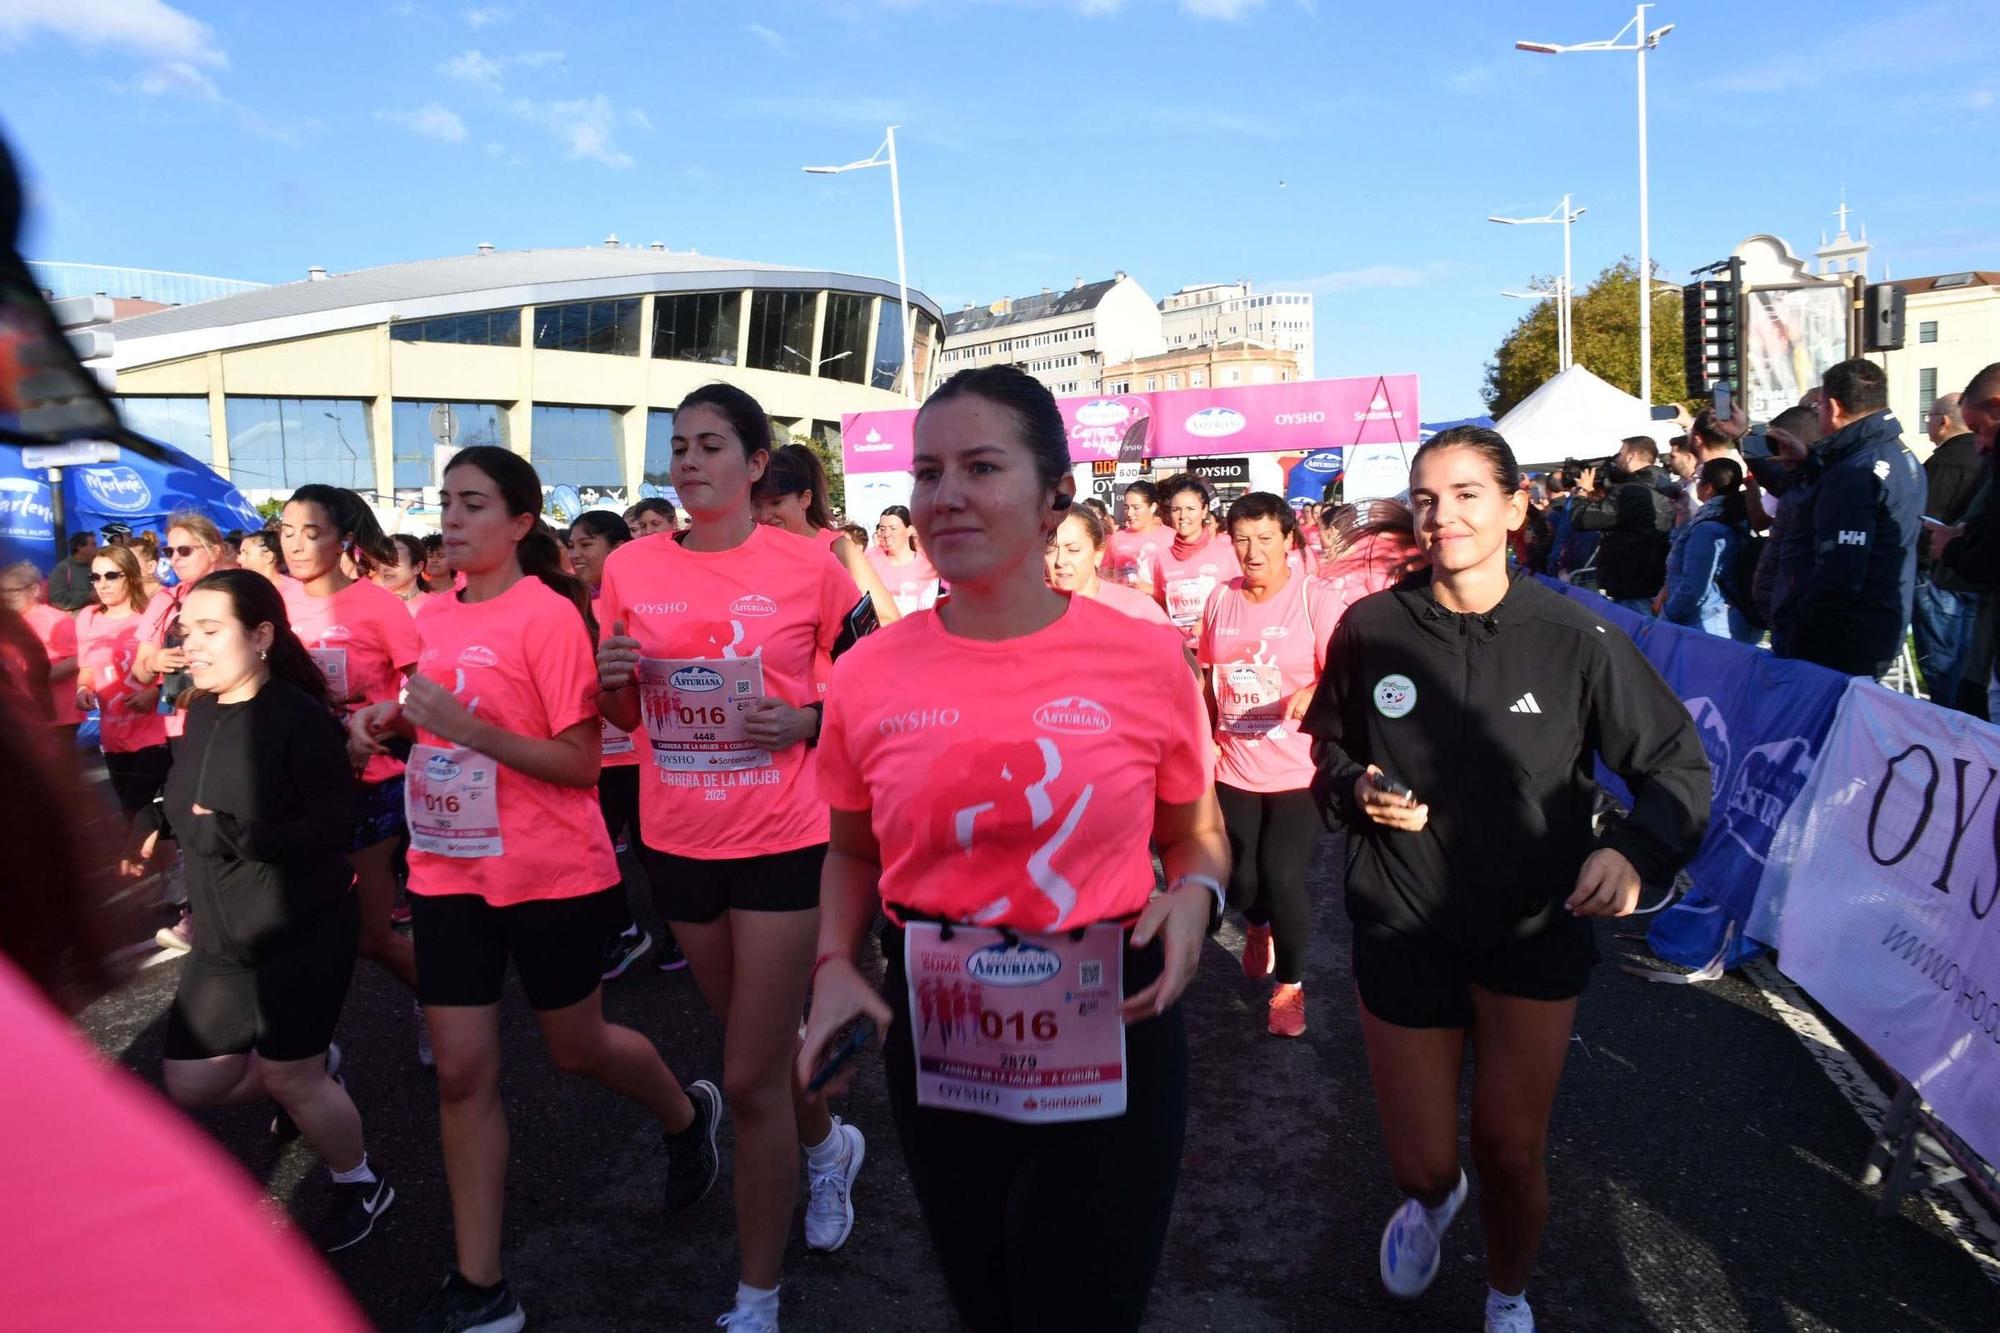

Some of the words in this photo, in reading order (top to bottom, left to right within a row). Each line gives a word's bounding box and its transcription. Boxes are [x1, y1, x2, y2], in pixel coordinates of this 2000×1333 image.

[1275, 411, 1326, 425] OYSHO
[1196, 465, 1242, 478] OYSHO
[1838, 530, 1866, 546] HH
[634, 601, 688, 614] OYSHO
[674, 675, 720, 686] ASTURIANA
[1233, 692, 1260, 704] 016
[679, 706, 726, 725] 016
[878, 707, 960, 737] OYSHO
[1040, 709, 1107, 729] ASTURIANA
[693, 732, 716, 741] 4448
[660, 754, 695, 764] OYSHO
[718, 755, 757, 765] Santander
[703, 772, 719, 788] DE
[721, 772, 736, 787] LA
[739, 769, 780, 786] MUJER
[425, 793, 460, 813] 016
[704, 789, 727, 801] 2025
[973, 957, 1054, 977] ASTURIANA
[979, 1008, 1059, 1042] 016
[1000, 1053, 1037, 1069] 2879
[1039, 1093, 1103, 1111] Santander
